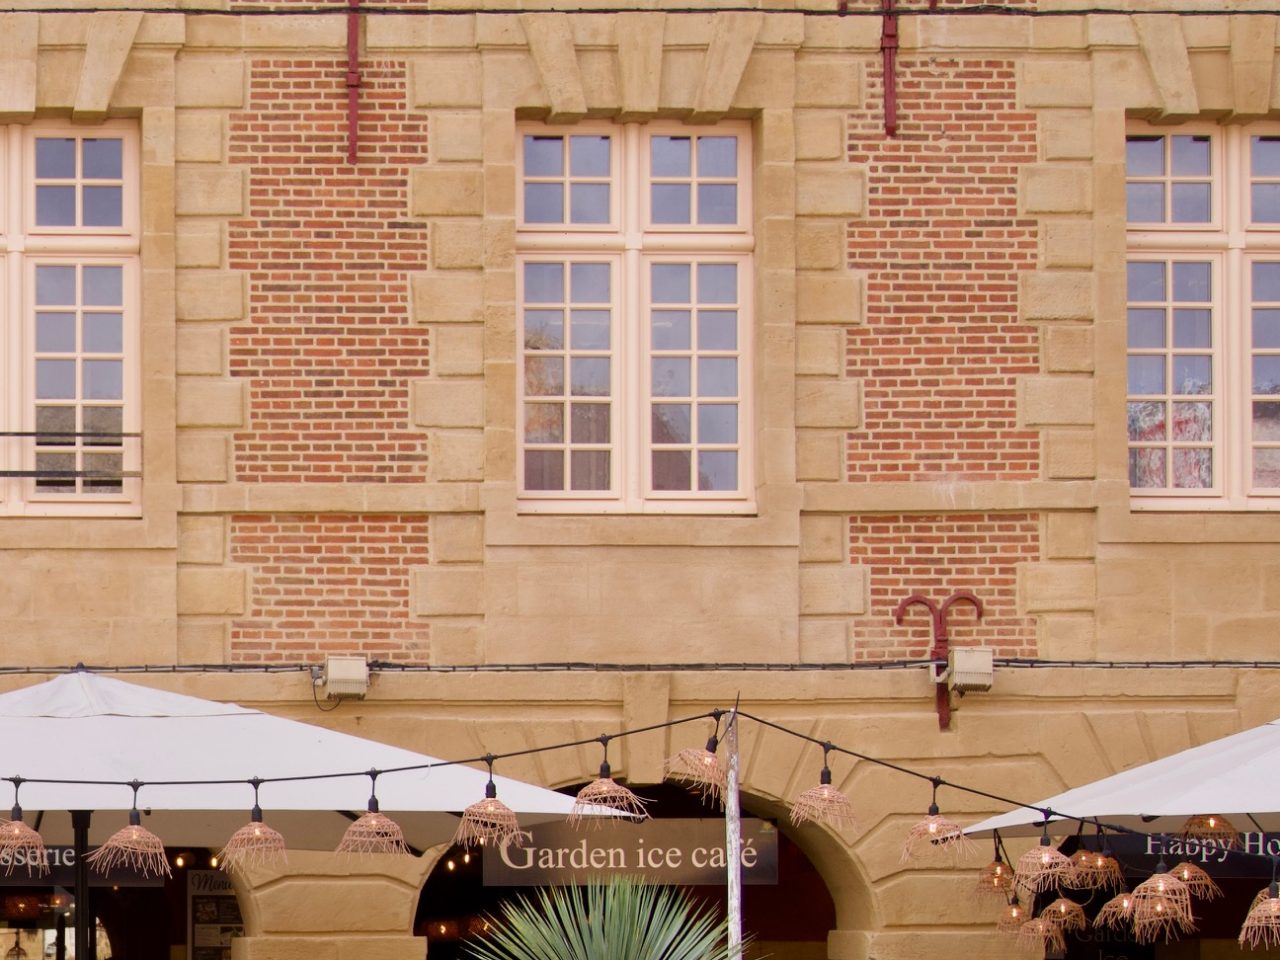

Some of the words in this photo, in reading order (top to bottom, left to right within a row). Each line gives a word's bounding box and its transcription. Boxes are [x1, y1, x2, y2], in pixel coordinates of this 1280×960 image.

[500, 831, 626, 869] Garden
[637, 838, 682, 869] ice
[691, 838, 758, 869] caé
[1144, 832, 1231, 863] Happy
